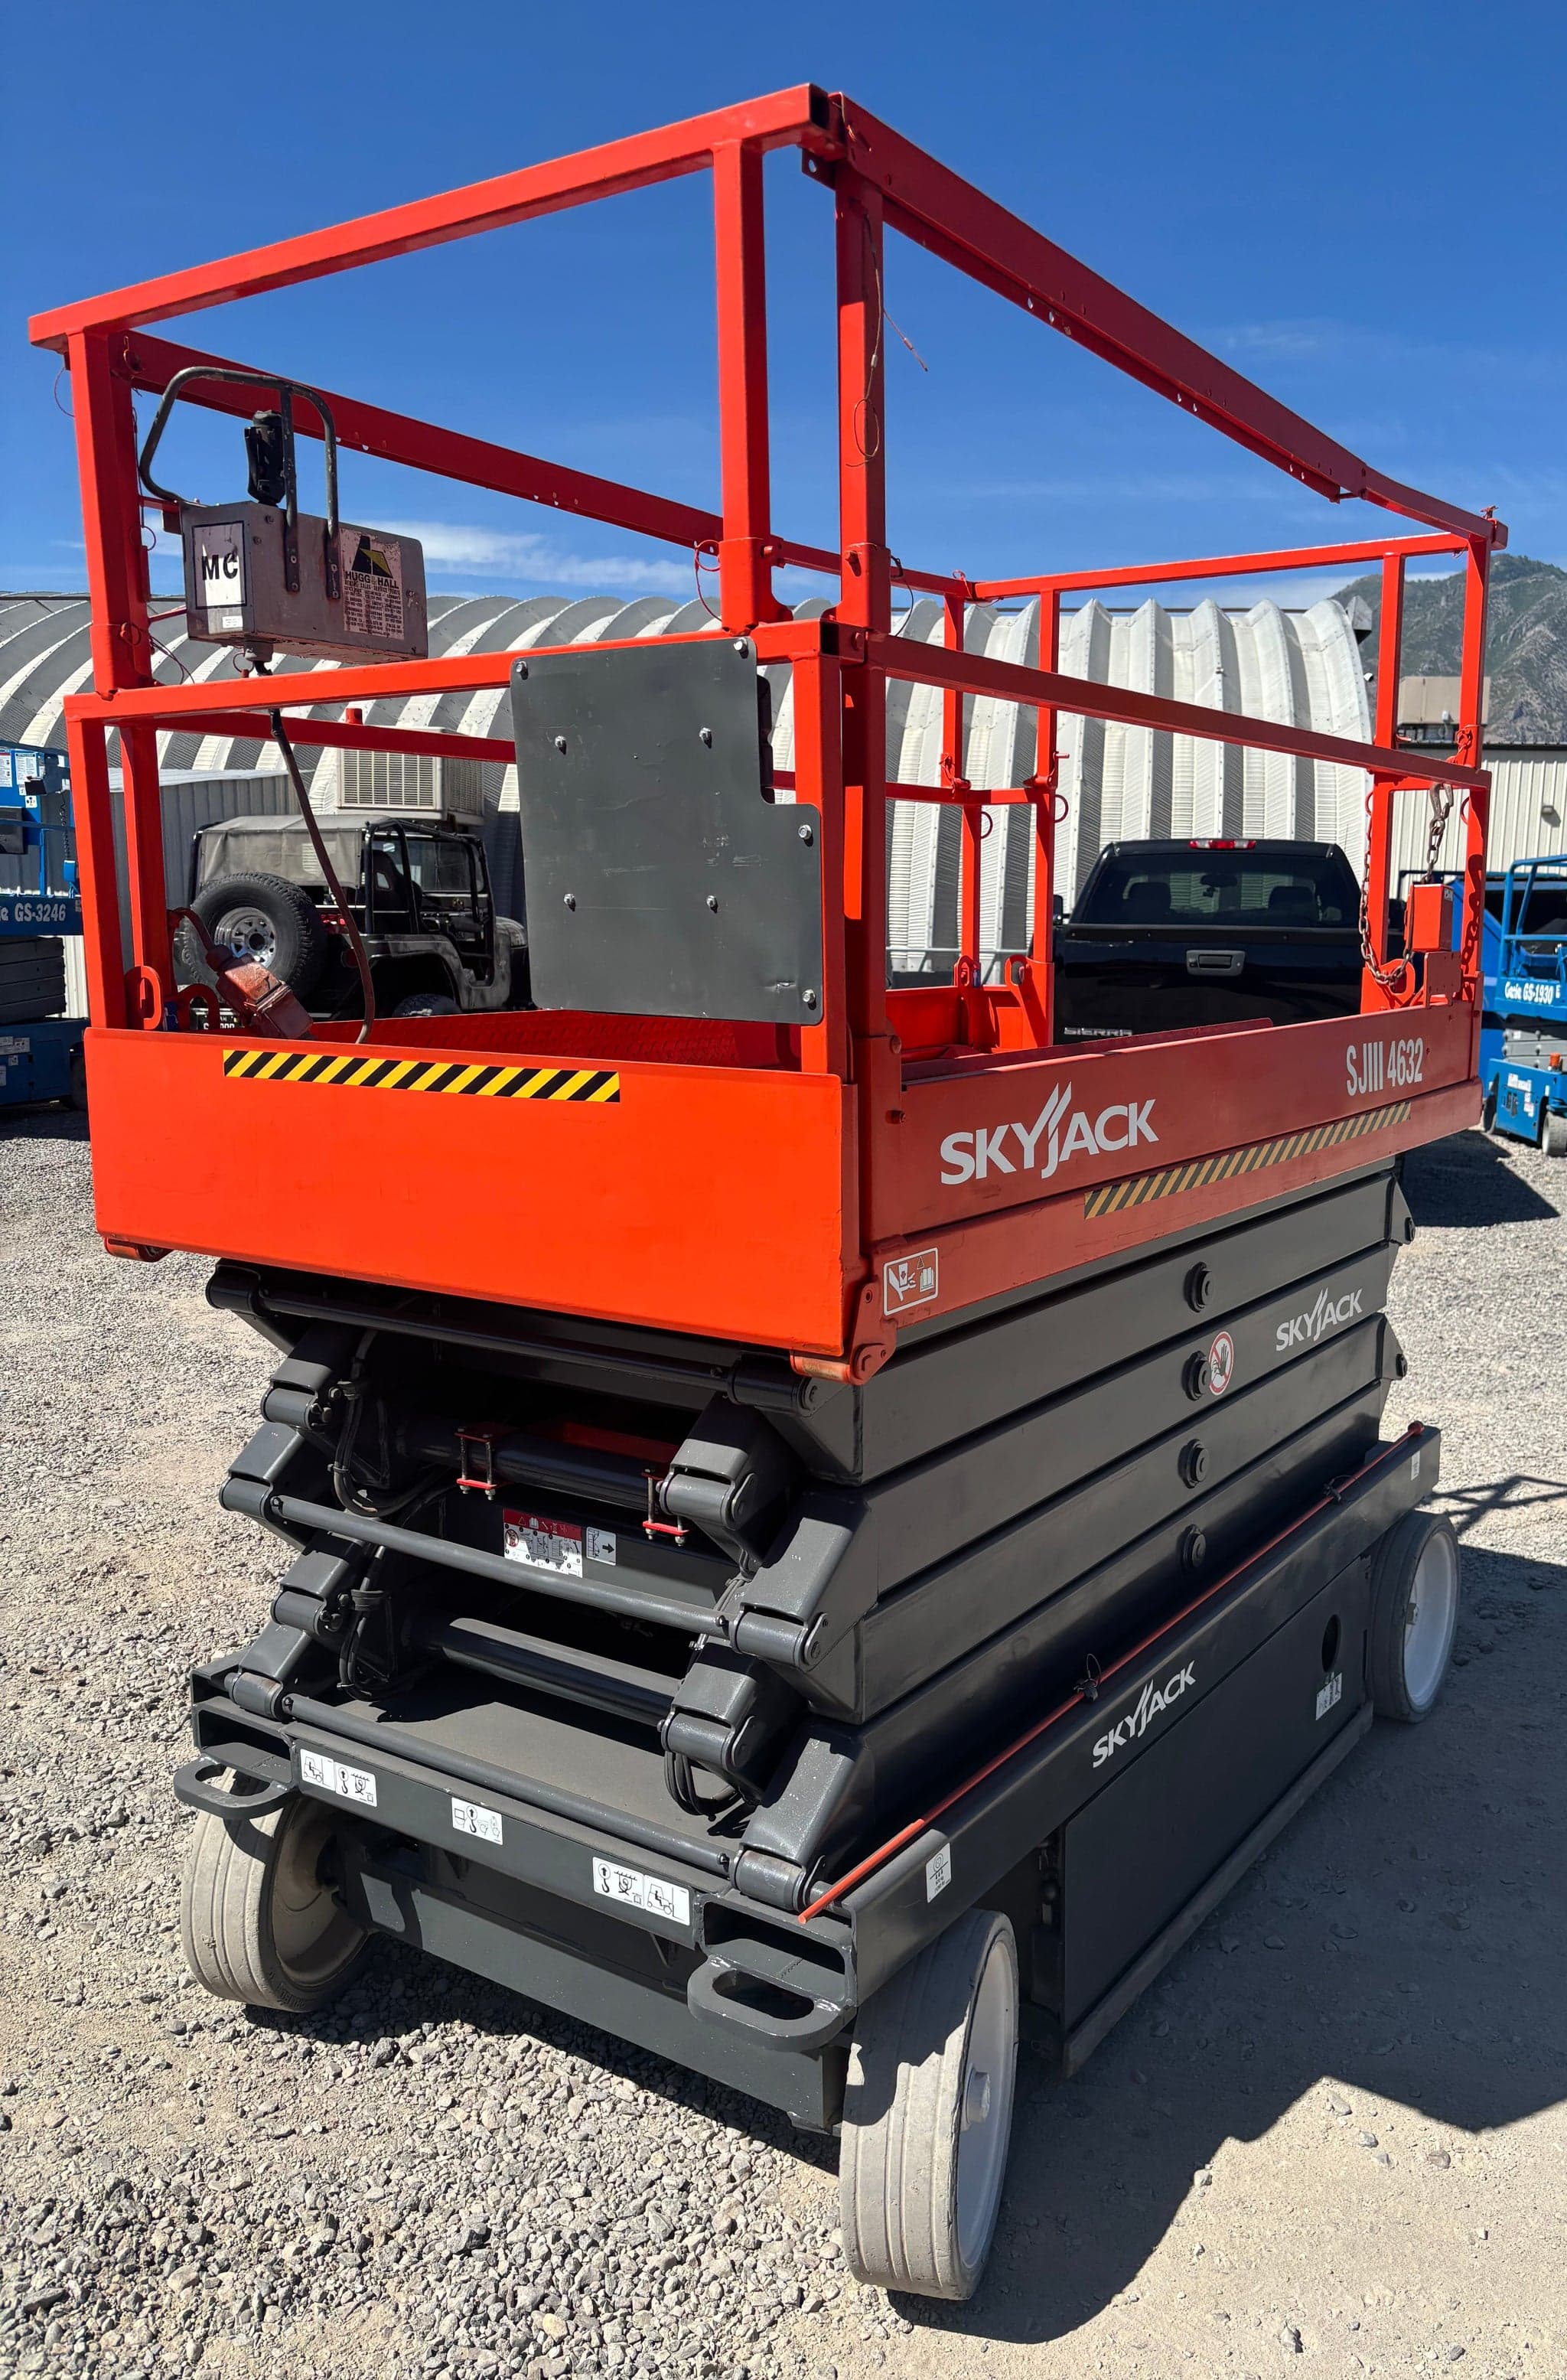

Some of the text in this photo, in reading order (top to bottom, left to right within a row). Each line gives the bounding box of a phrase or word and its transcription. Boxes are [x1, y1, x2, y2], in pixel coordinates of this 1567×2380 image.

[345, 571, 371, 583] HUGG
[377, 577, 399, 588] HALL
[15, 902, 67, 922] GS-3246
[1523, 983, 1554, 1005] GS-1930
[1387, 1037, 1424, 1087] 4632
[940, 1081, 1159, 1185] SKYJACK
[1275, 1286, 1363, 1351] SKYJACK
[1093, 1659, 1197, 1769] SKYJACK
